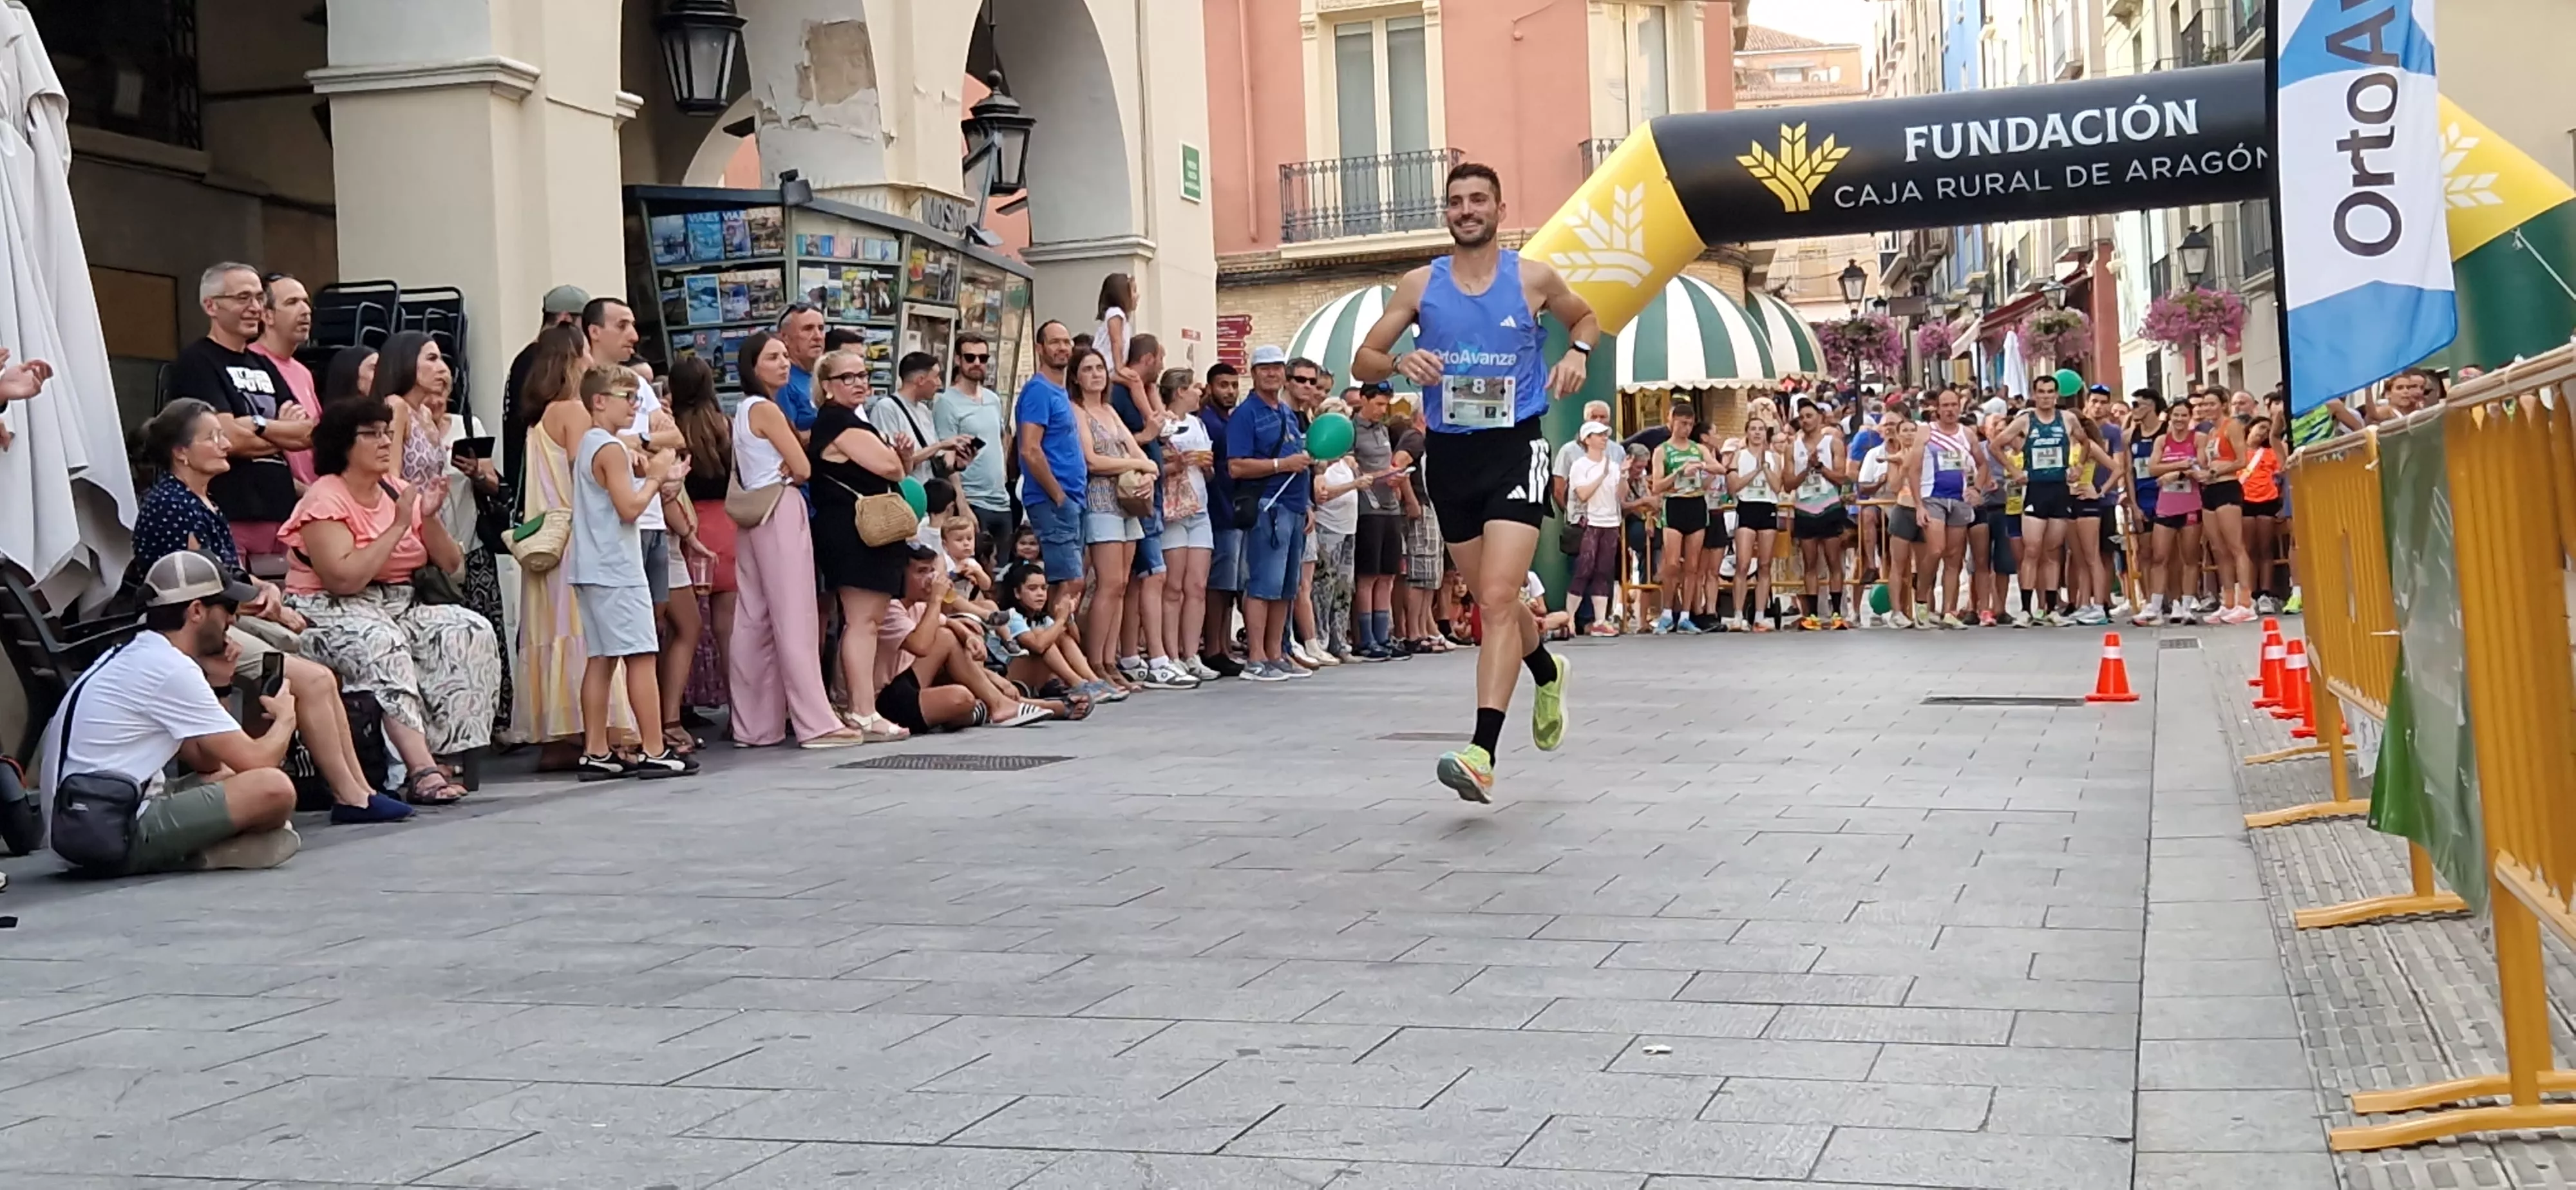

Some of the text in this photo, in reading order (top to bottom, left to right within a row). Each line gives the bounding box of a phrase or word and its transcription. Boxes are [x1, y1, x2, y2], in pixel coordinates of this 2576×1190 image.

[1904, 94, 2199, 162] FUNDACIÓN
[2325, 0, 2402, 256] OrtoA
[1835, 180, 1923, 208] CAJA
[1937, 169, 2053, 199] RURAL
[2065, 162, 2111, 187] DE
[1472, 378, 1486, 394] 8
